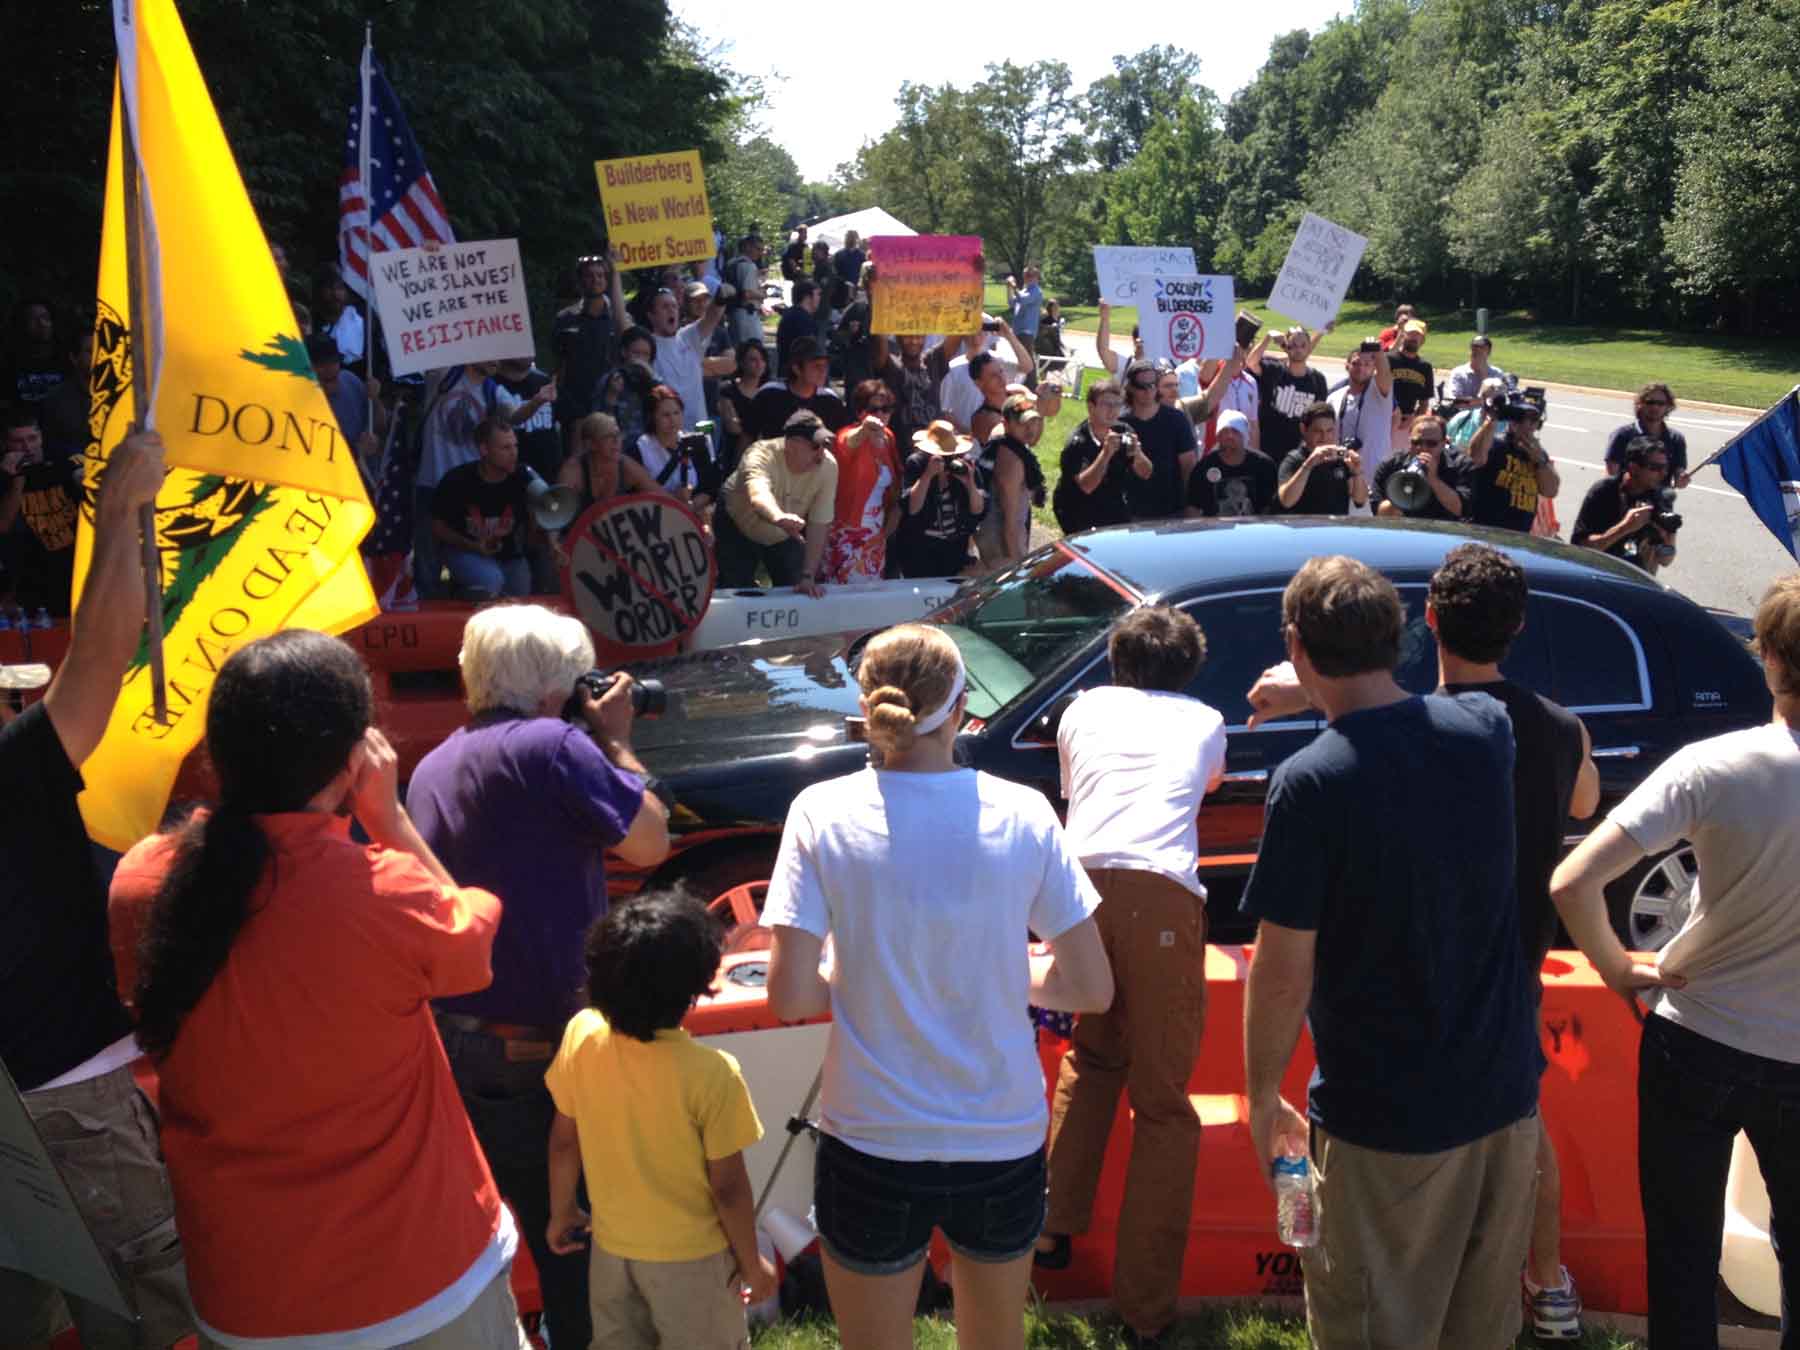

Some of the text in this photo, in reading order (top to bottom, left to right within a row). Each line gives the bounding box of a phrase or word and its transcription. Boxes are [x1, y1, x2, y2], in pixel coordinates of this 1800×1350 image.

[603, 161, 693, 187] Builderberg
[624, 202, 659, 224] New
[661, 194, 705, 219] World
[382, 251, 486, 282] WE ARE NOT
[620, 235, 708, 265] Order Scum
[398, 263, 516, 298] YOUR SLAVES!
[1165, 281, 1204, 297] OCCUPY
[402, 290, 509, 323] WE ARE THE
[400, 314, 525, 354] RESISTANCE
[187, 393, 337, 464] DONT
[591, 504, 663, 552] NEW
[576, 531, 709, 612] WORLD
